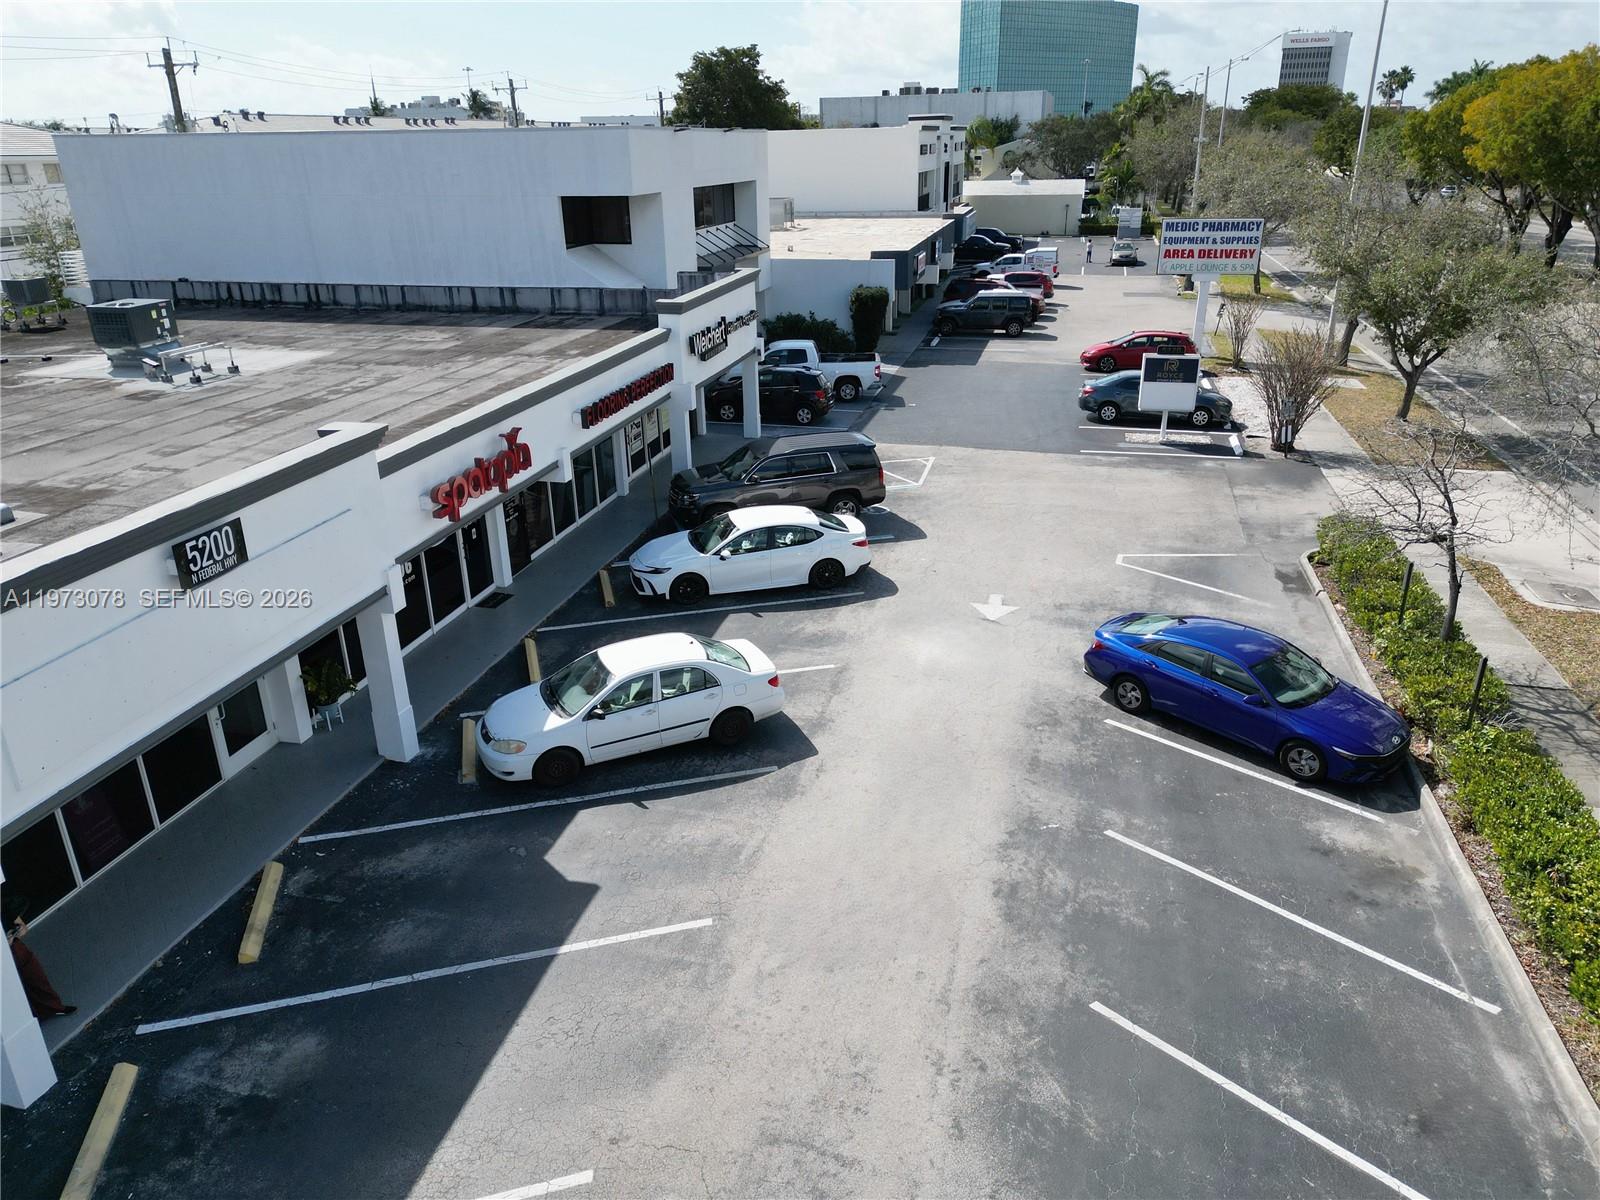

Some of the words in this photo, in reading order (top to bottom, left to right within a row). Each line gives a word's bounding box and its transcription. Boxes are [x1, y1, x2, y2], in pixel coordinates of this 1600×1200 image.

[1163, 236, 1210, 245] EQUIPMENT
[1212, 237, 1218, 245] &
[1220, 236, 1259, 245] SUPPLIES
[1165, 221, 1199, 232] MEDIC
[1202, 221, 1262, 232] PHARMACY
[1163, 248, 1194, 259] AREA
[1198, 248, 1256, 259] DELIVERY
[1170, 263, 1194, 271] APPLE
[1196, 263, 1228, 271] LOUNGE
[1230, 263, 1237, 271] &
[1240, 263, 1255, 271] SPA
[690, 317, 727, 356] Weichert
[581, 384, 632, 429] FLOORING
[628, 363, 674, 404] PERFECTION
[430, 427, 532, 522] spatopia
[185, 526, 235, 572] 5200
[191, 573, 198, 584] N
[198, 562, 224, 581] FEDERAL
[223, 554, 238, 569] HWY
